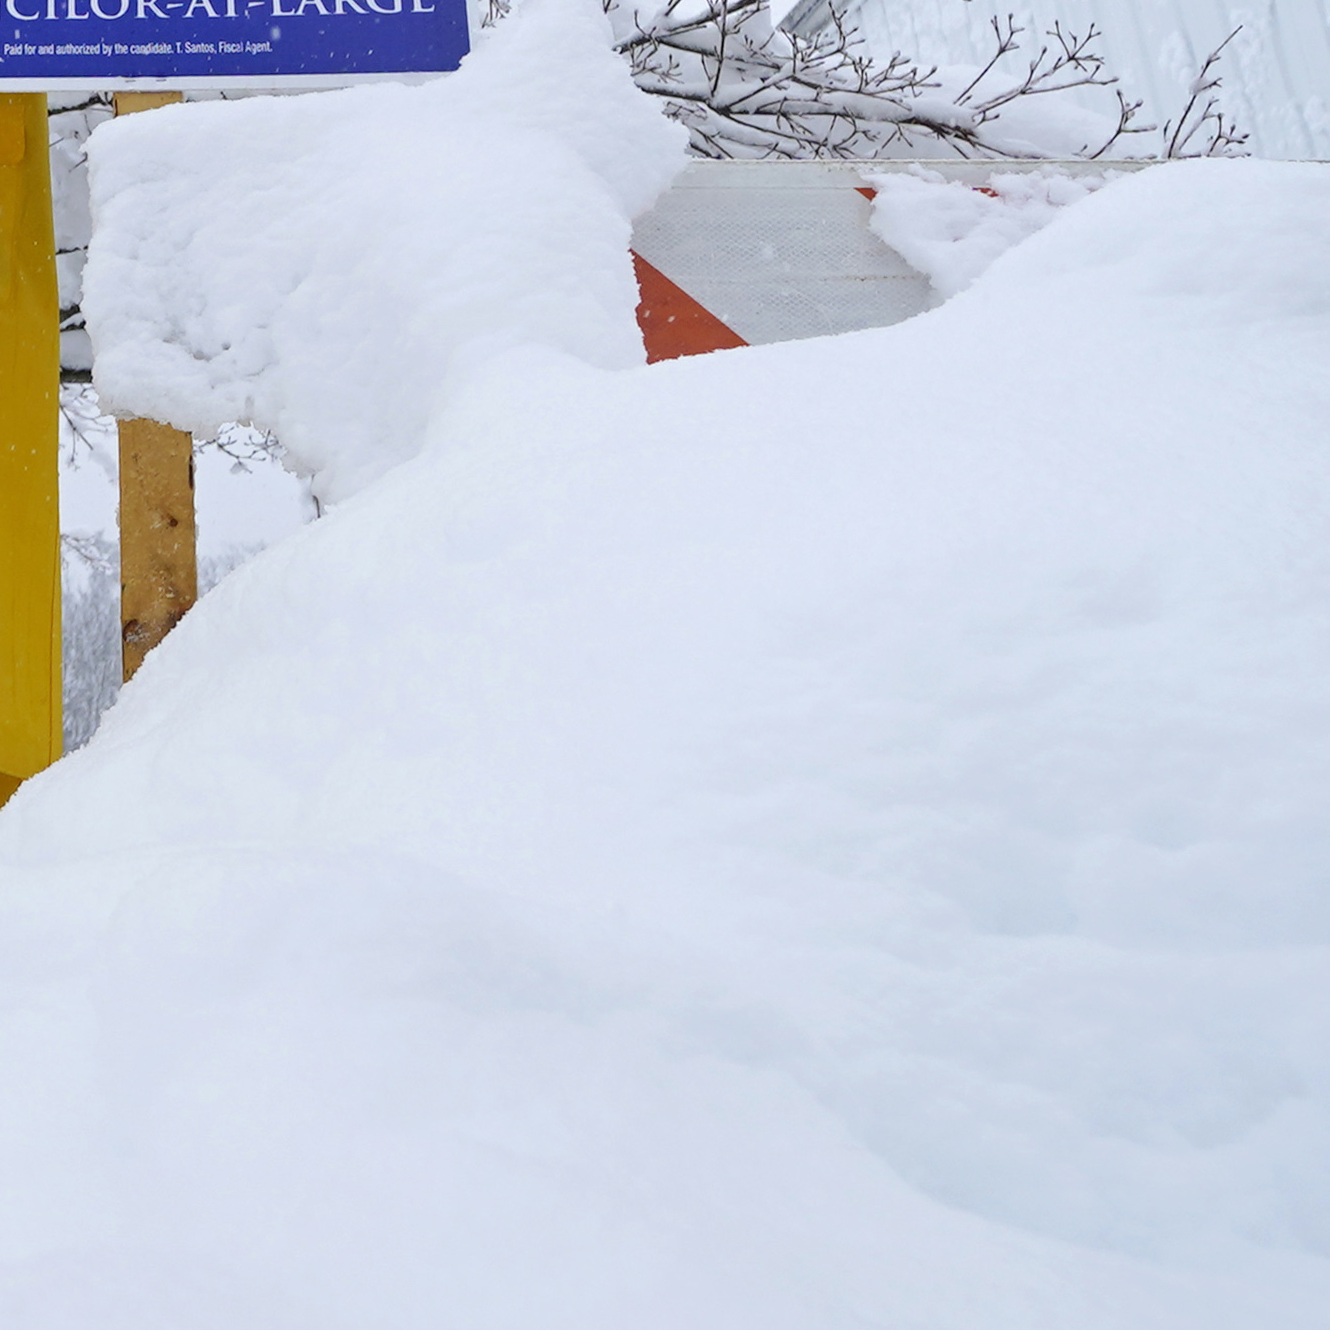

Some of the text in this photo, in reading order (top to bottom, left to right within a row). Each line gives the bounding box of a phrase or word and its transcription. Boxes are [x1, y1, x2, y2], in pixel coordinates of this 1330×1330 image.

[3, 43, 23, 56] Paid
[24, 43, 37, 56] for
[38, 43, 54, 55] and
[56, 43, 101, 56] authorized
[102, 43, 113, 57] by
[114, 42, 129, 55] the
[175, 42, 184, 54] T.
[218, 41, 244, 54] Fiscal
[245, 41, 273, 56] Agent.
